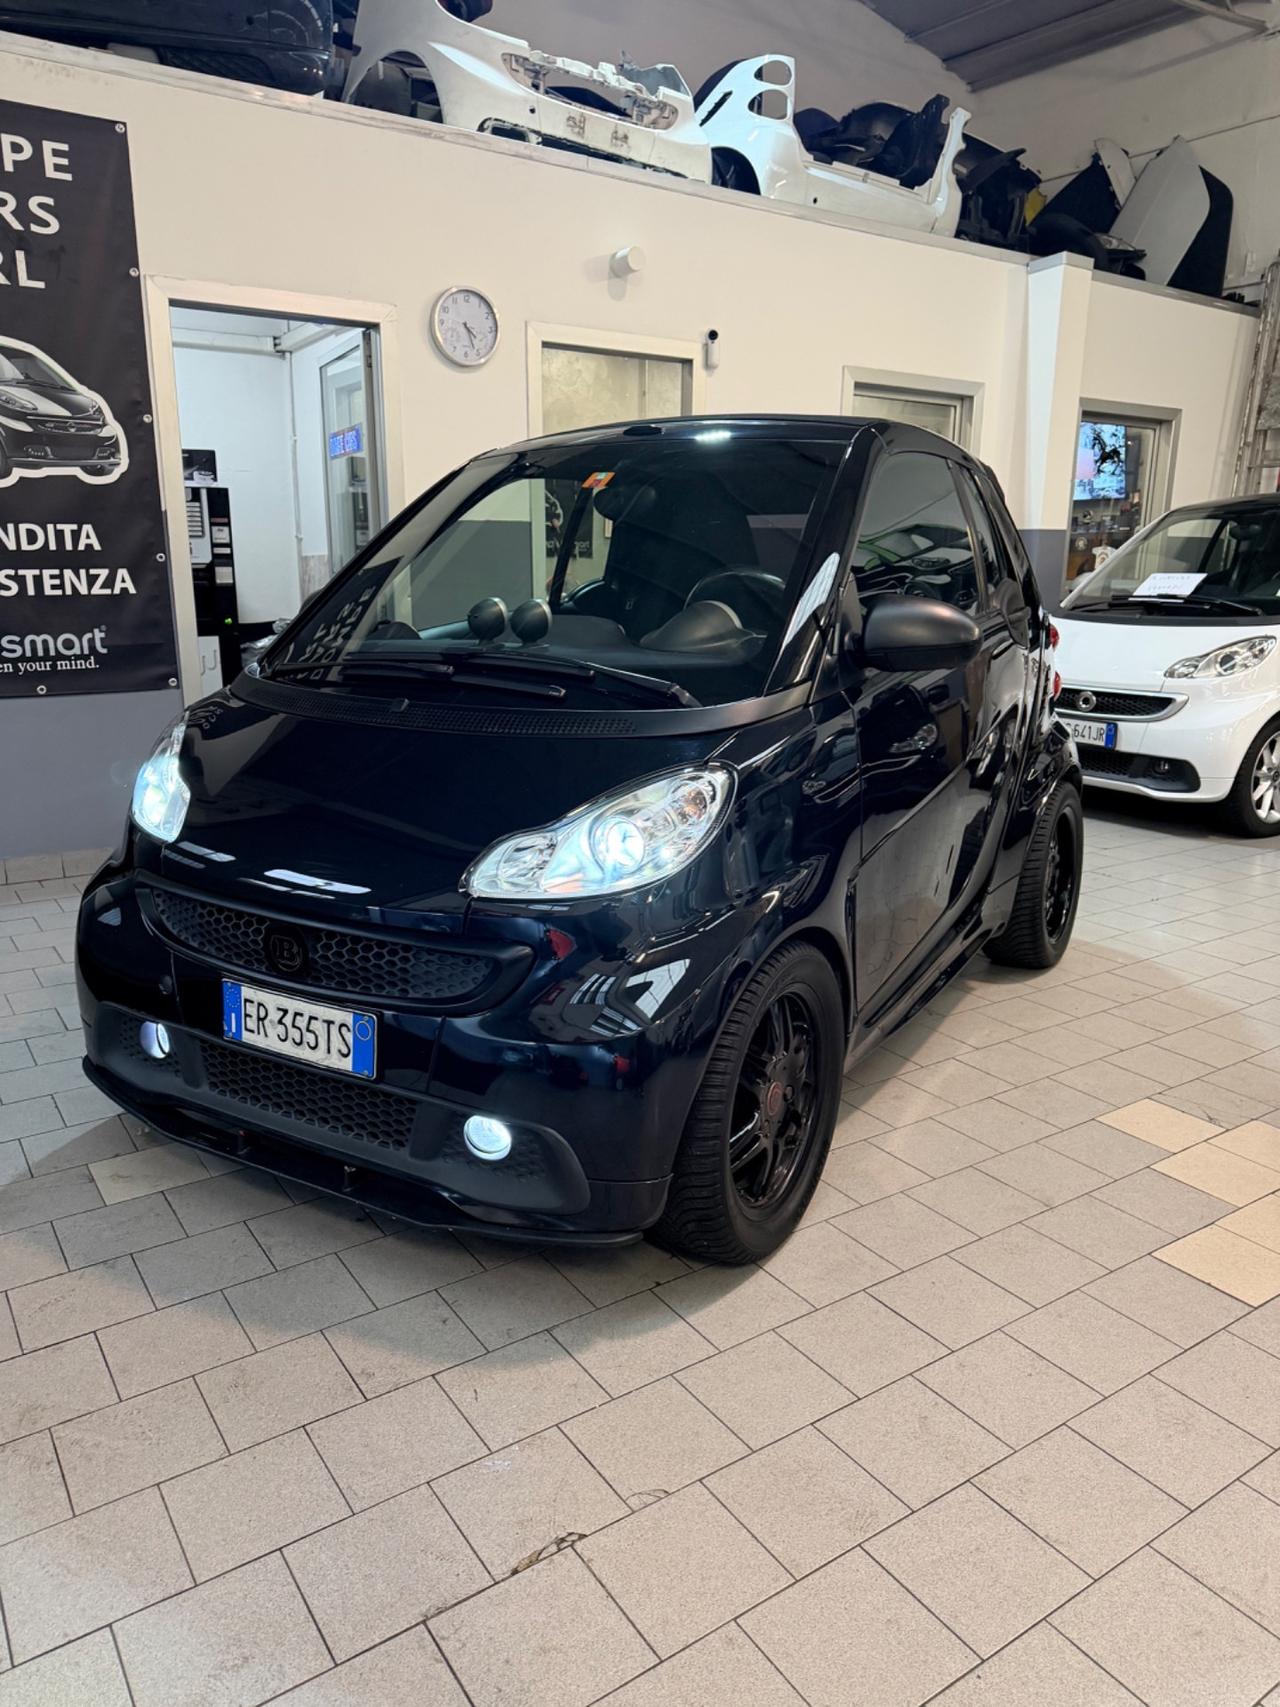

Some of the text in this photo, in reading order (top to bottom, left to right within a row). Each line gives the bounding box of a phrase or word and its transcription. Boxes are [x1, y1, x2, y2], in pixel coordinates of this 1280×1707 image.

[0, 133, 73, 181] PE
[0, 523, 102, 551] NDITA
[0, 568, 137, 597] STENZA
[0, 628, 108, 658] smart
[17, 661, 53, 675] your
[56, 656, 100, 670] mind.
